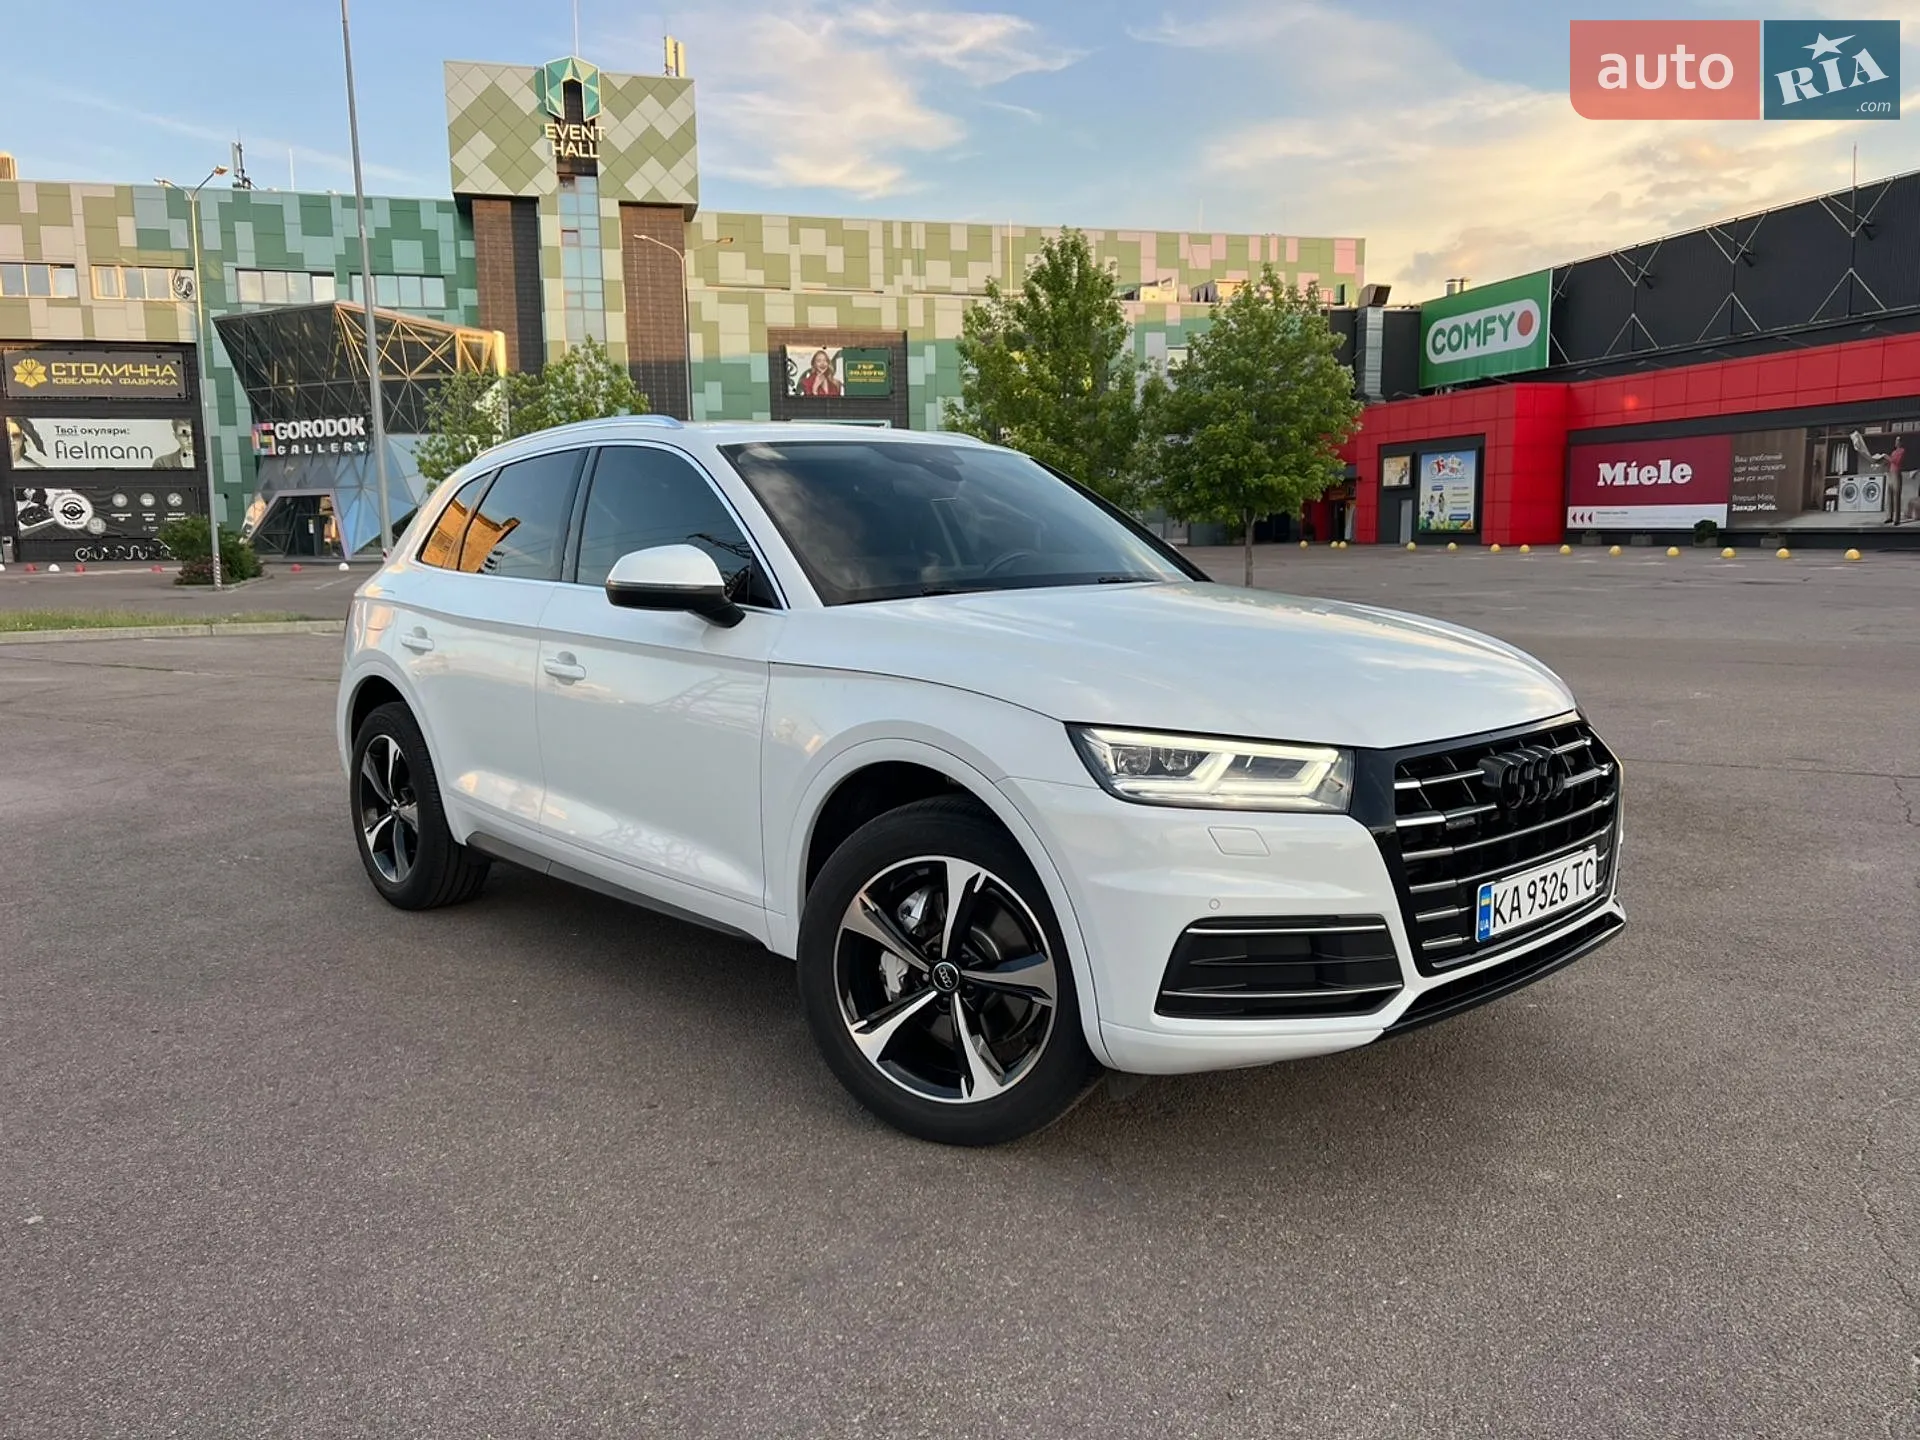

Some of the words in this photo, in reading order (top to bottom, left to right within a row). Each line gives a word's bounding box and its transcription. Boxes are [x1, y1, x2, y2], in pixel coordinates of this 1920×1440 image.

[544, 123, 605, 141] EVENT
[551, 140, 600, 158] HALL
[1431, 311, 1515, 356] COMFY
[51, 362, 177, 377] СТОЛИЧНА
[119, 377, 178, 386] ФАБРИКА
[55, 425, 78, 436] Твої
[80, 426, 130, 436] окуляри:
[275, 417, 366, 440] GORODOK
[55, 440, 153, 460] fielmann
[277, 441, 366, 455] GALLERY
[1597, 459, 1693, 487] Miele
[1493, 885, 1522, 928] KA
[1527, 867, 1568, 915] 9326
[1572, 858, 1594, 895] TC
